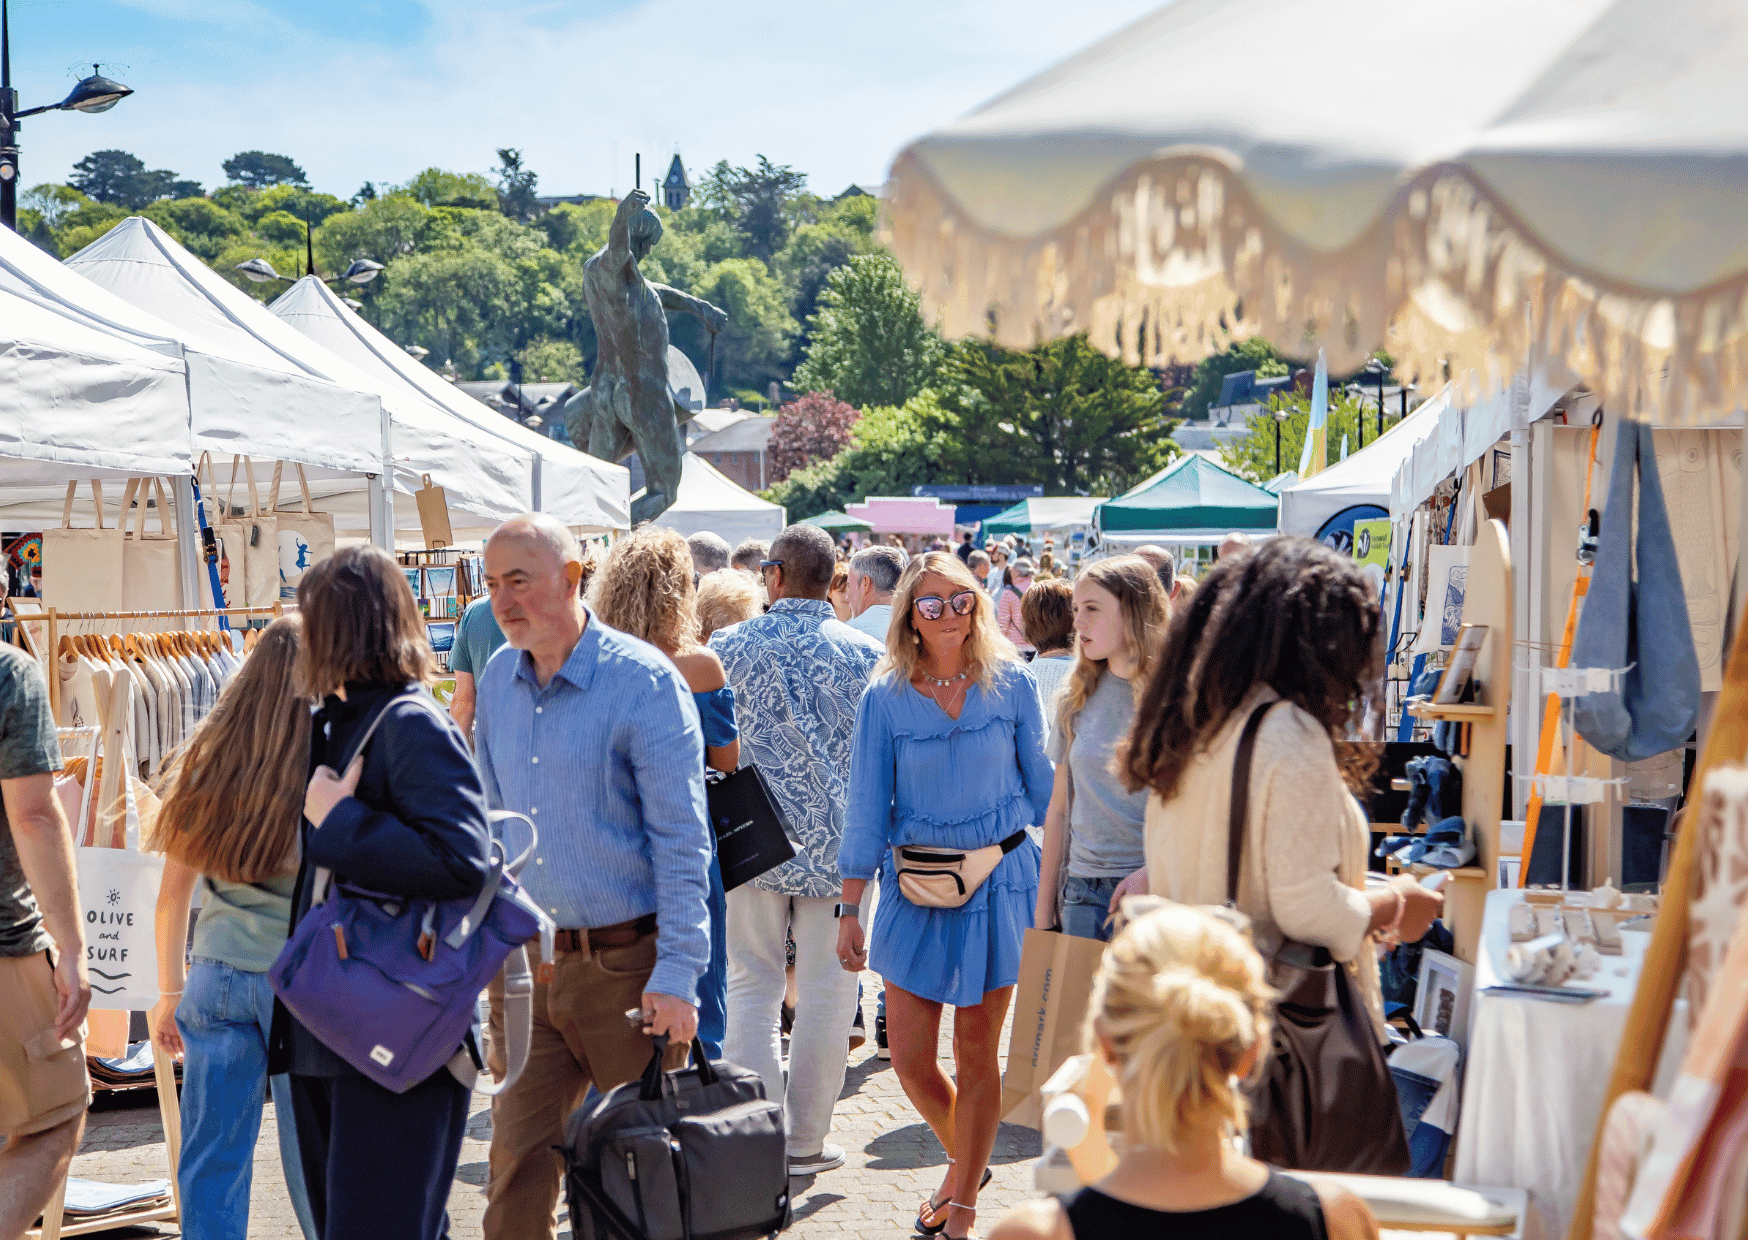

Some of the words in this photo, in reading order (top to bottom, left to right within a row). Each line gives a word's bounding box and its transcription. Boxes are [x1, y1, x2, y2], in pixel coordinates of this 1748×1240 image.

[87, 910, 133, 926] OLIVE
[99, 930, 120, 941] and
[87, 946, 129, 962] SURF
[1032, 968, 1053, 1067] rimarkcom
